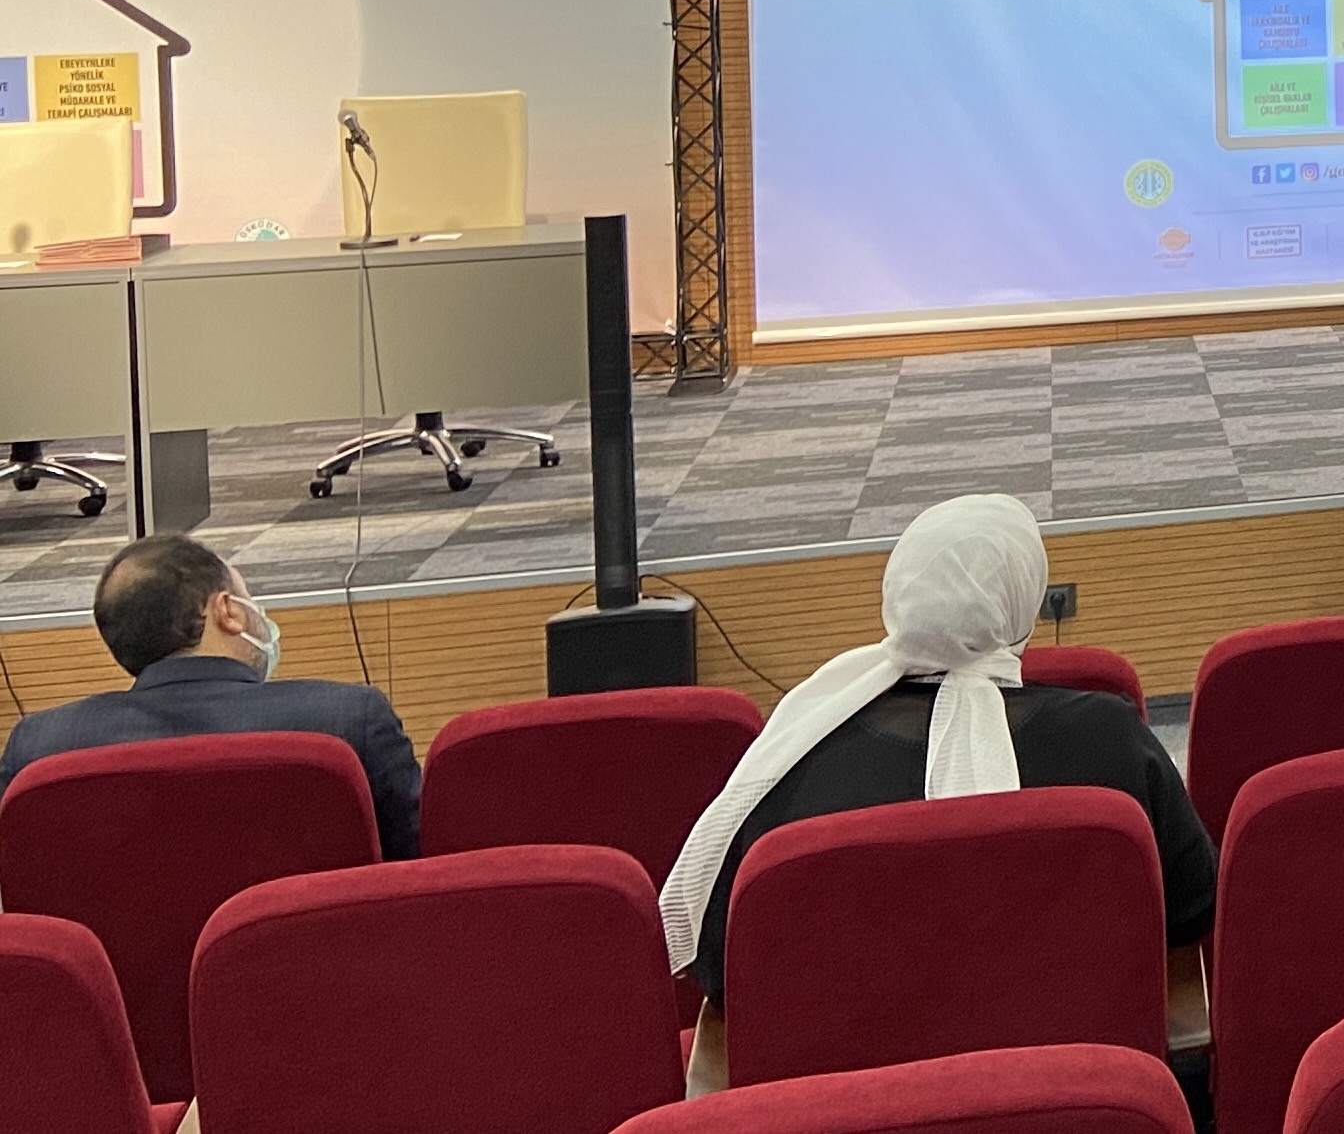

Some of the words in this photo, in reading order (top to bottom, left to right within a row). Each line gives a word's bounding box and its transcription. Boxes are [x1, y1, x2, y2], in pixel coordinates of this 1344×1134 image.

[59, 83, 83, 94] PSİKO
[85, 83, 115, 92] SOSYAL
[106, 96, 116, 104] VE
[48, 108, 77, 119] TERAPİ
